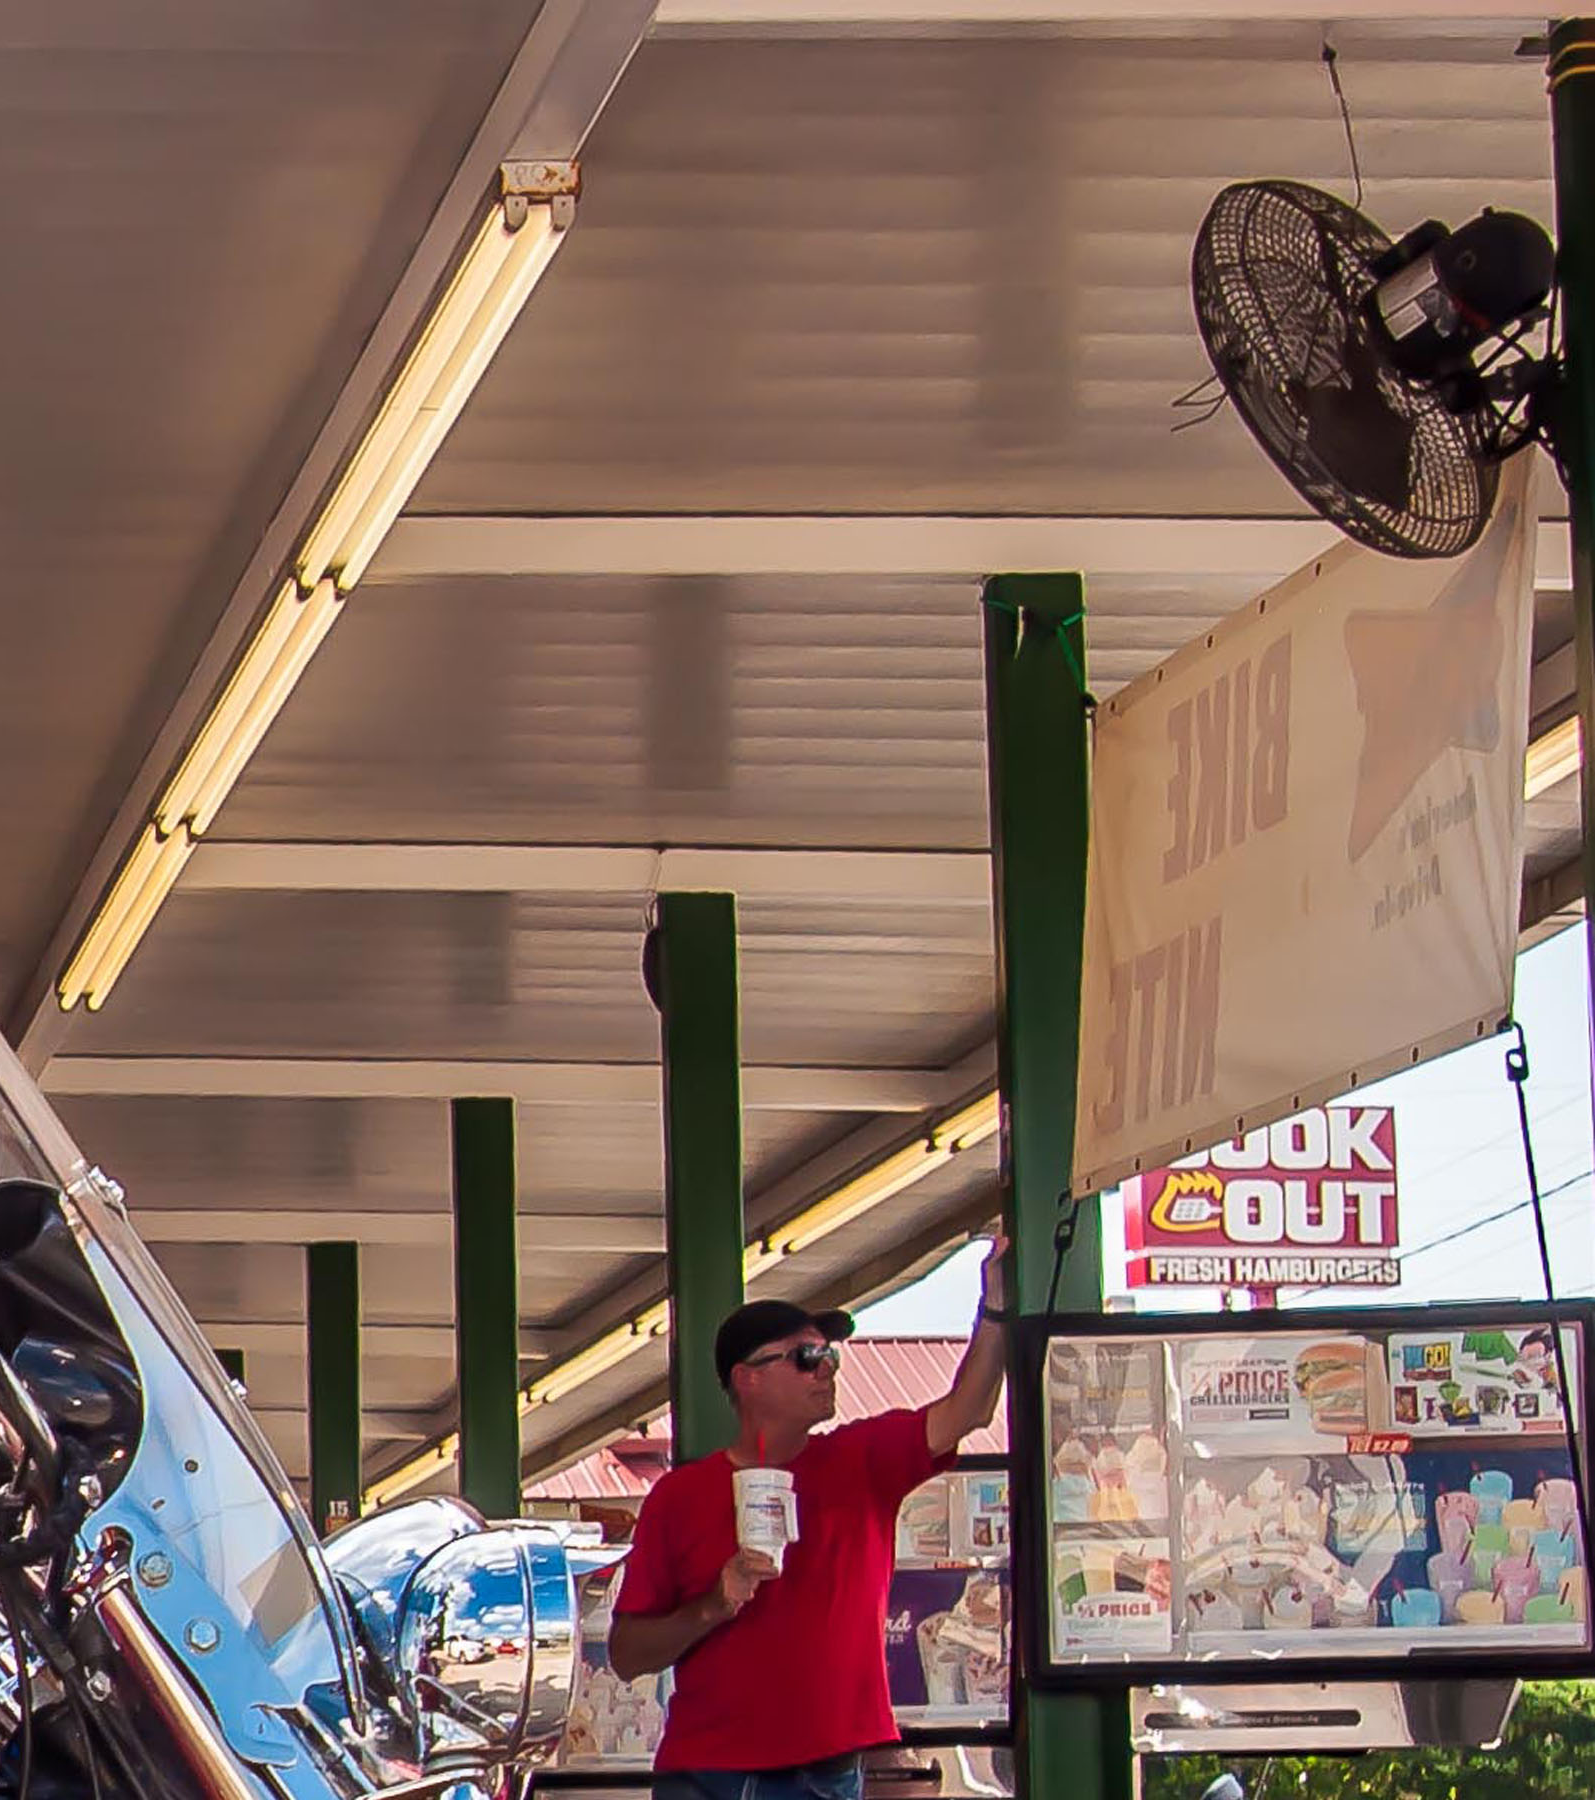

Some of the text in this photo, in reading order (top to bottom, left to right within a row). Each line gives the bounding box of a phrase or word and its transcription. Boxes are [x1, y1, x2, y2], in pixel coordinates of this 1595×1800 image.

[1224, 1179, 1395, 1244] OUT
[1151, 1258, 1399, 1283] FRESH HAMBURGERS
[1219, 1370, 1289, 1396] PRICE
[1098, 1602, 1151, 1617] PRICE
